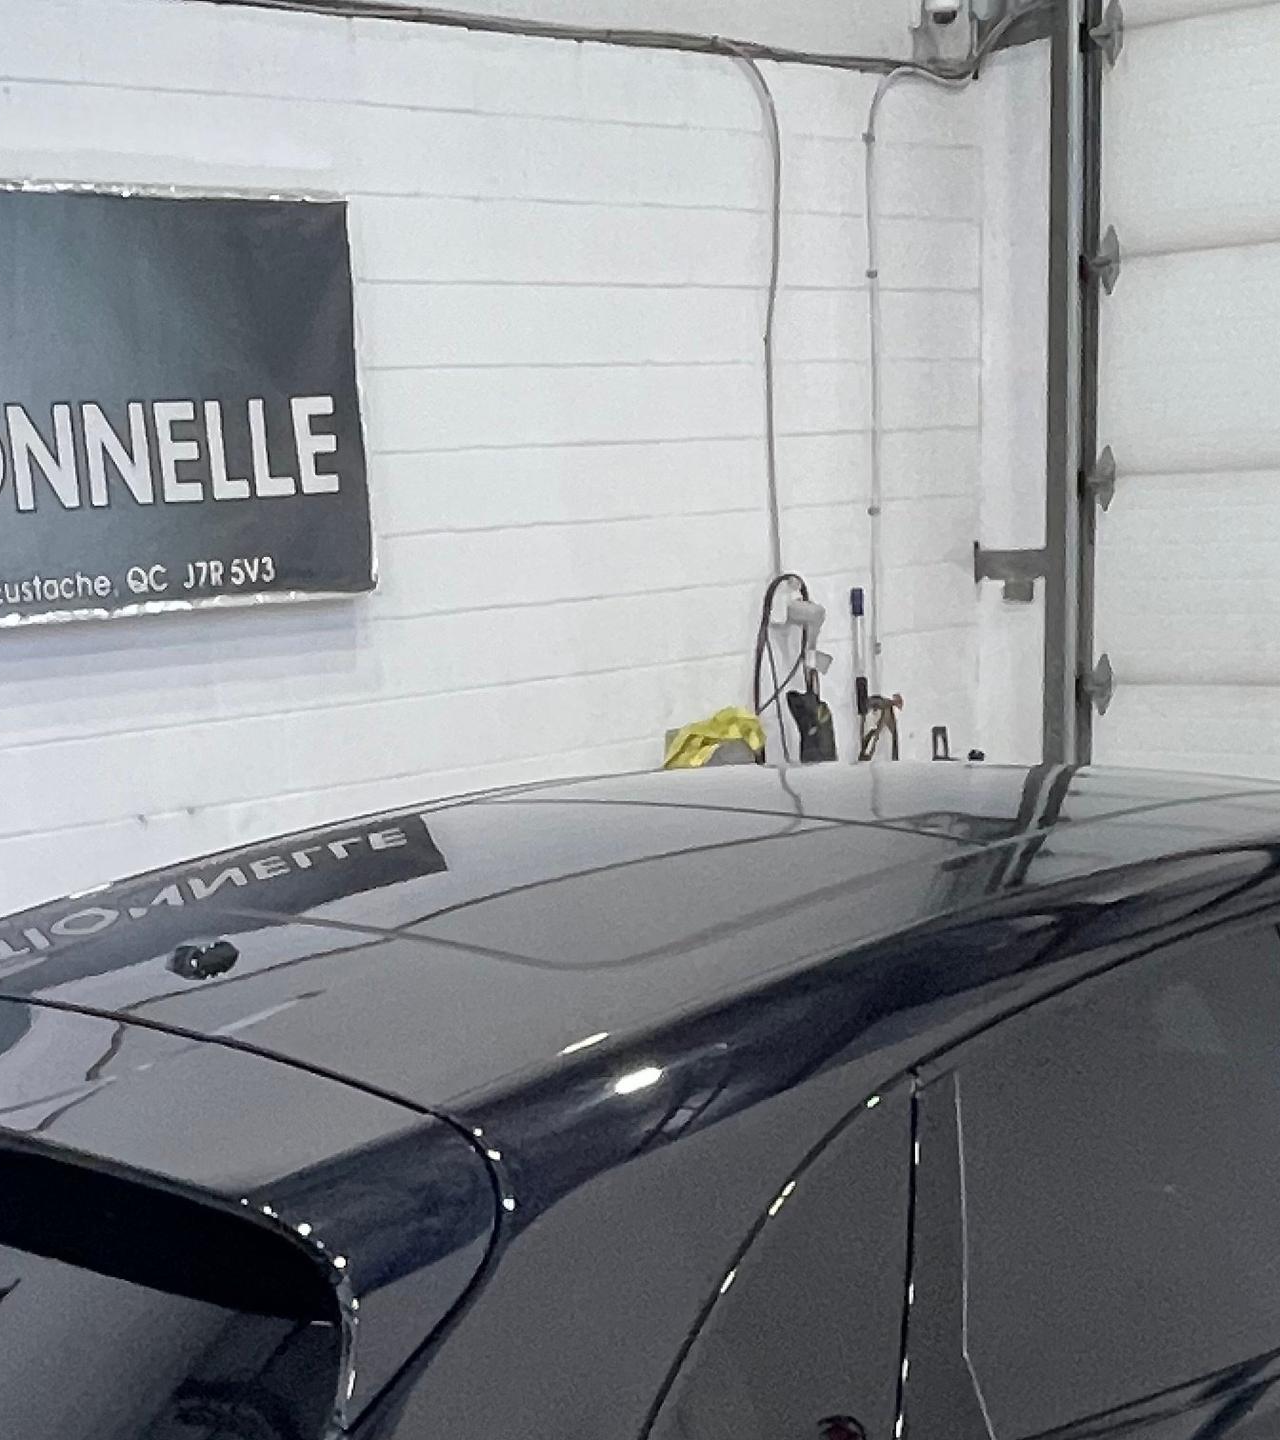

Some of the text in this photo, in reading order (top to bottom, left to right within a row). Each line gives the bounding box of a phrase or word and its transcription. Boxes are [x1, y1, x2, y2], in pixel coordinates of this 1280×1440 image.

[126, 564, 168, 594] QC
[184, 561, 223, 590] J7R
[230, 556, 276, 586] 5V3
